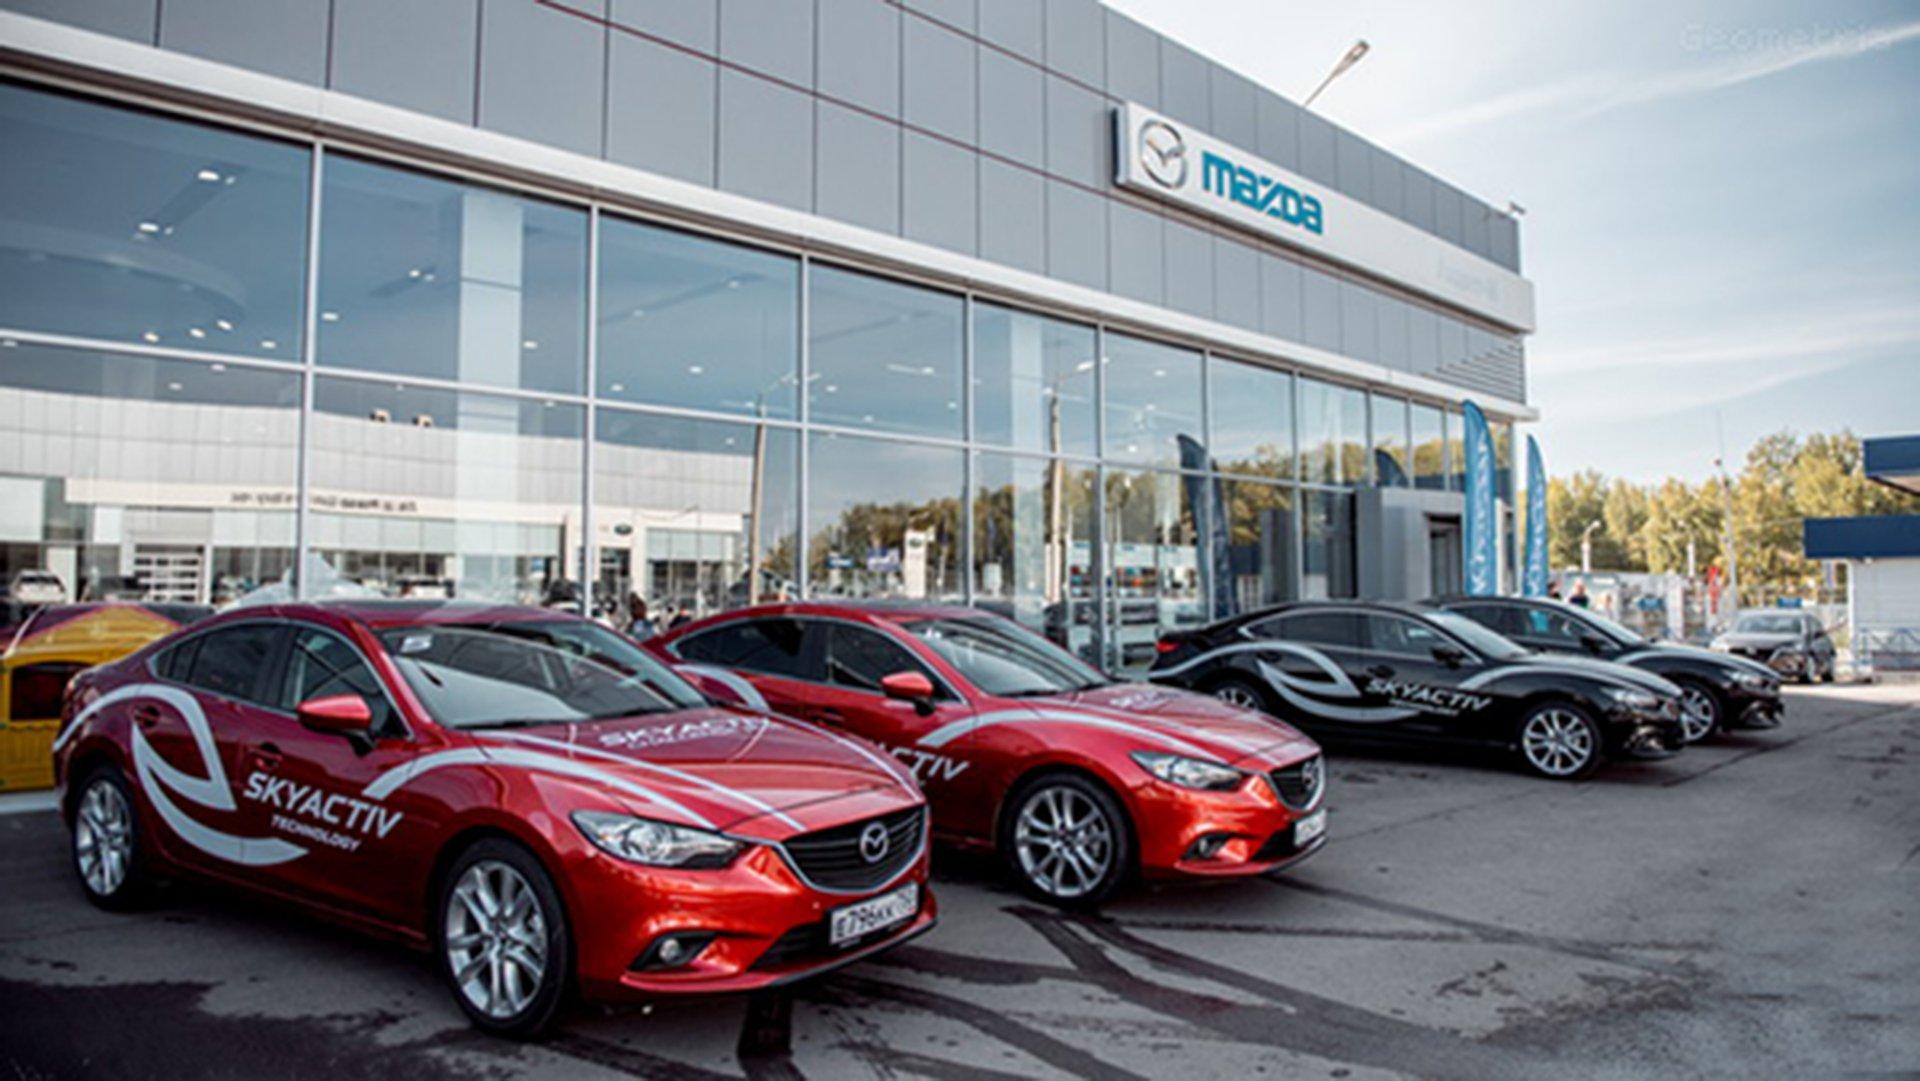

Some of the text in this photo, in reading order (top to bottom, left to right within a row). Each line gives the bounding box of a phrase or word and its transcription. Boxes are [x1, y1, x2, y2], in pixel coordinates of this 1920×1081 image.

[1202, 150, 1324, 235] mazda
[1366, 678, 1492, 711] SKYACTIV
[243, 771, 403, 838] SKYACTIV
[271, 814, 361, 851] TECHNOLOGY
